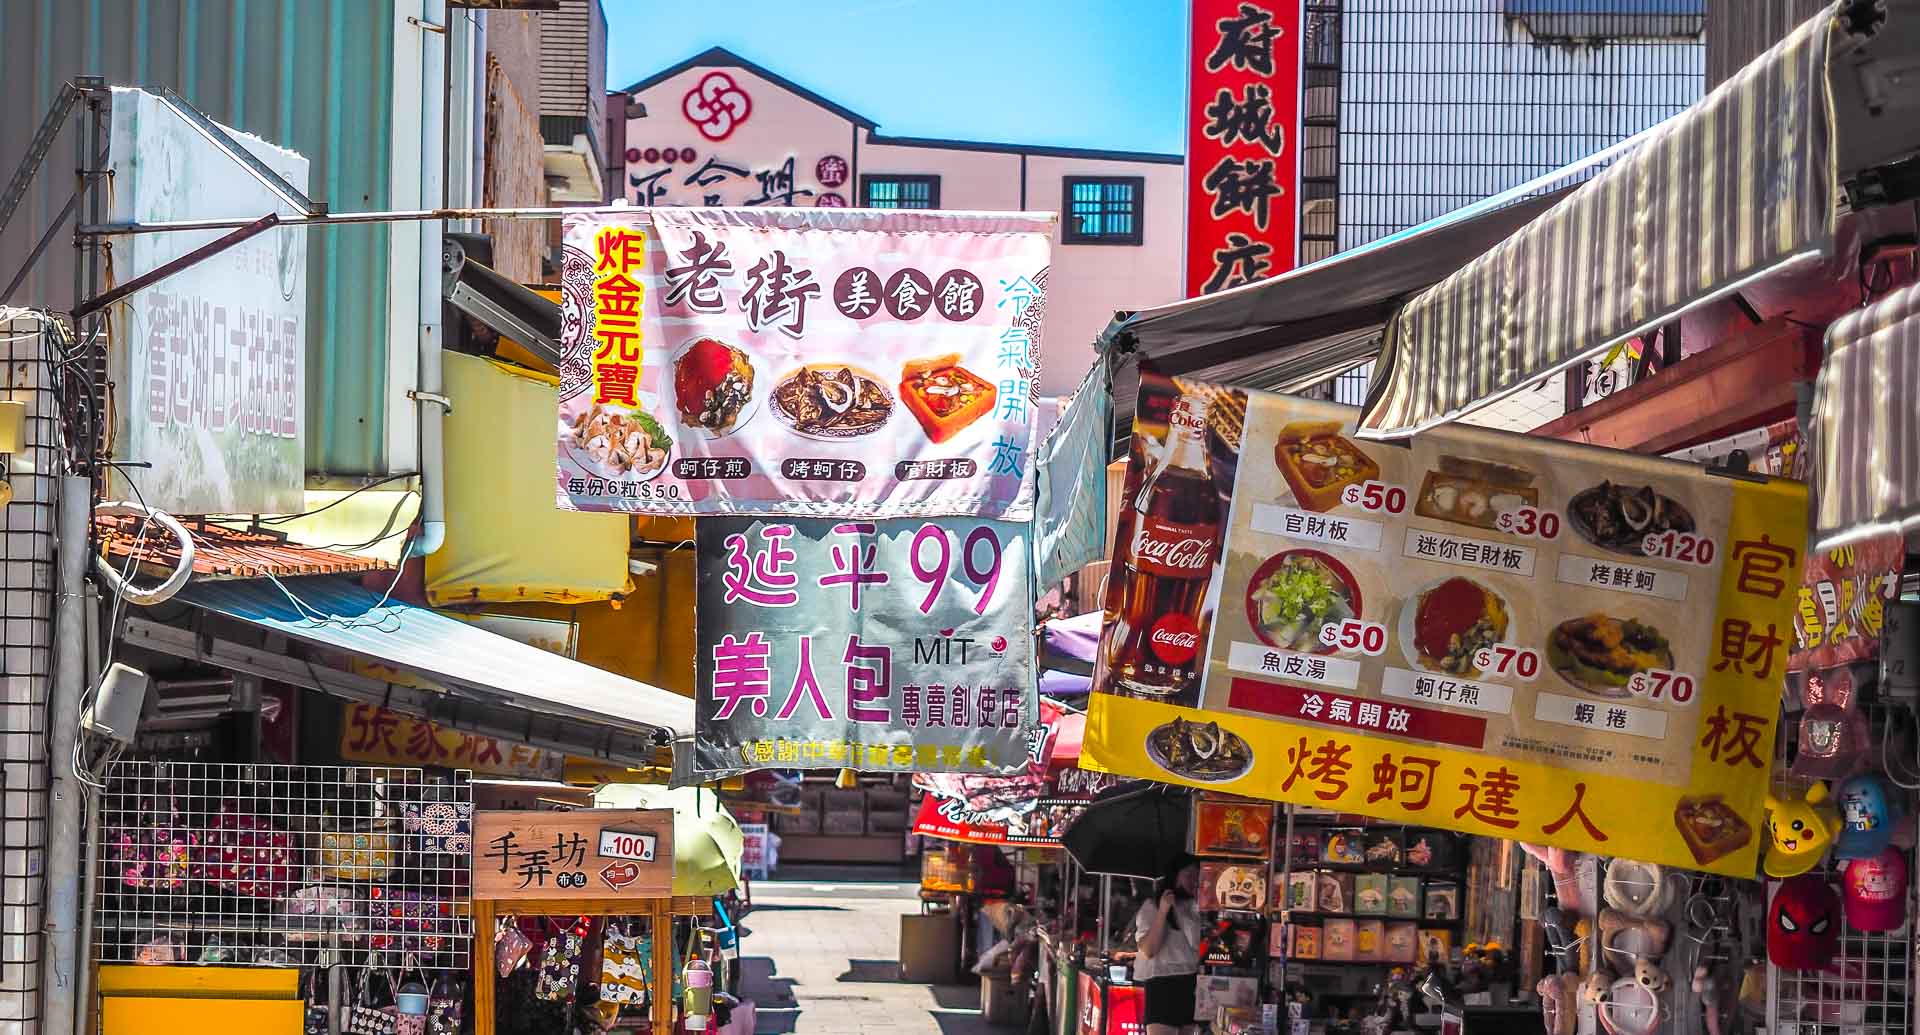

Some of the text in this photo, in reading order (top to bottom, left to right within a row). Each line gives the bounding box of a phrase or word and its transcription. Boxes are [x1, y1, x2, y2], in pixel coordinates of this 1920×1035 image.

[1201, 3, 1284, 295] 府城餅店
[595, 230, 642, 406] 炸金元寶
[989, 275, 1041, 480] 冷氣開放
[1169, 412, 1203, 428] Coke
[679, 460, 746, 478] 蚵仔煎
[790, 461, 859, 479] 烤蚵仔
[904, 459, 971, 479] 官財板
[1345, 485, 1406, 513] $50
[1284, 513, 1350, 542] 官財板
[1499, 509, 1559, 538] $30
[1131, 530, 1213, 569] Coca-Cola
[1416, 535, 1523, 569] 迷你官財板
[1646, 533, 1714, 565] $120
[1590, 563, 1656, 591] 烤鮮蚵
[914, 638, 975, 665] MIT
[1152, 628, 1201, 648] Coca-Cola
[1325, 623, 1384, 651] $50
[1702, 534, 1797, 768] 官財板
[1261, 652, 1326, 679] 魚皮湯
[1477, 648, 1538, 677] $70
[712, 633, 892, 723] 美人包
[1415, 677, 1480, 705] 蚵仔煎
[1631, 672, 1693, 702] $70
[901, 684, 1020, 729] 專賣創使店
[1300, 694, 1411, 732] 冷氣開放
[1281, 736, 1609, 843] 烤蚵達人
[484, 831, 589, 889] 手弄坊
[613, 835, 645, 857] 100
[558, 873, 587, 887] 布包
[1209, 953, 1231, 961] MINI
